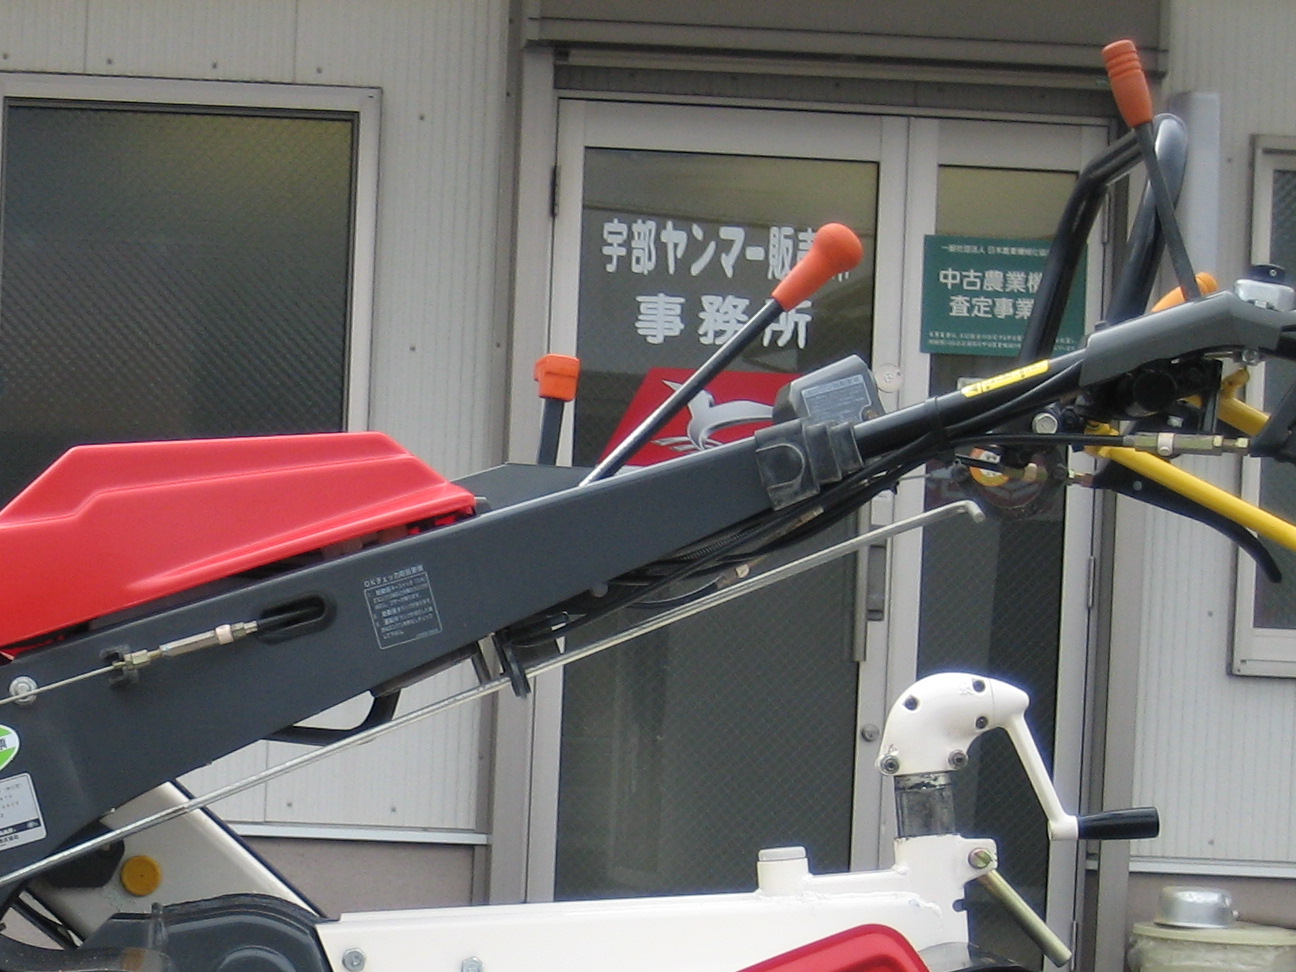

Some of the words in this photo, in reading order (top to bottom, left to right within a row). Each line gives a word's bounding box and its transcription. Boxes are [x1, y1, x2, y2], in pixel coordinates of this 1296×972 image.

[602, 218, 850, 282] 宇部ヤンマー販
[634, 293, 813, 349] 事務所
